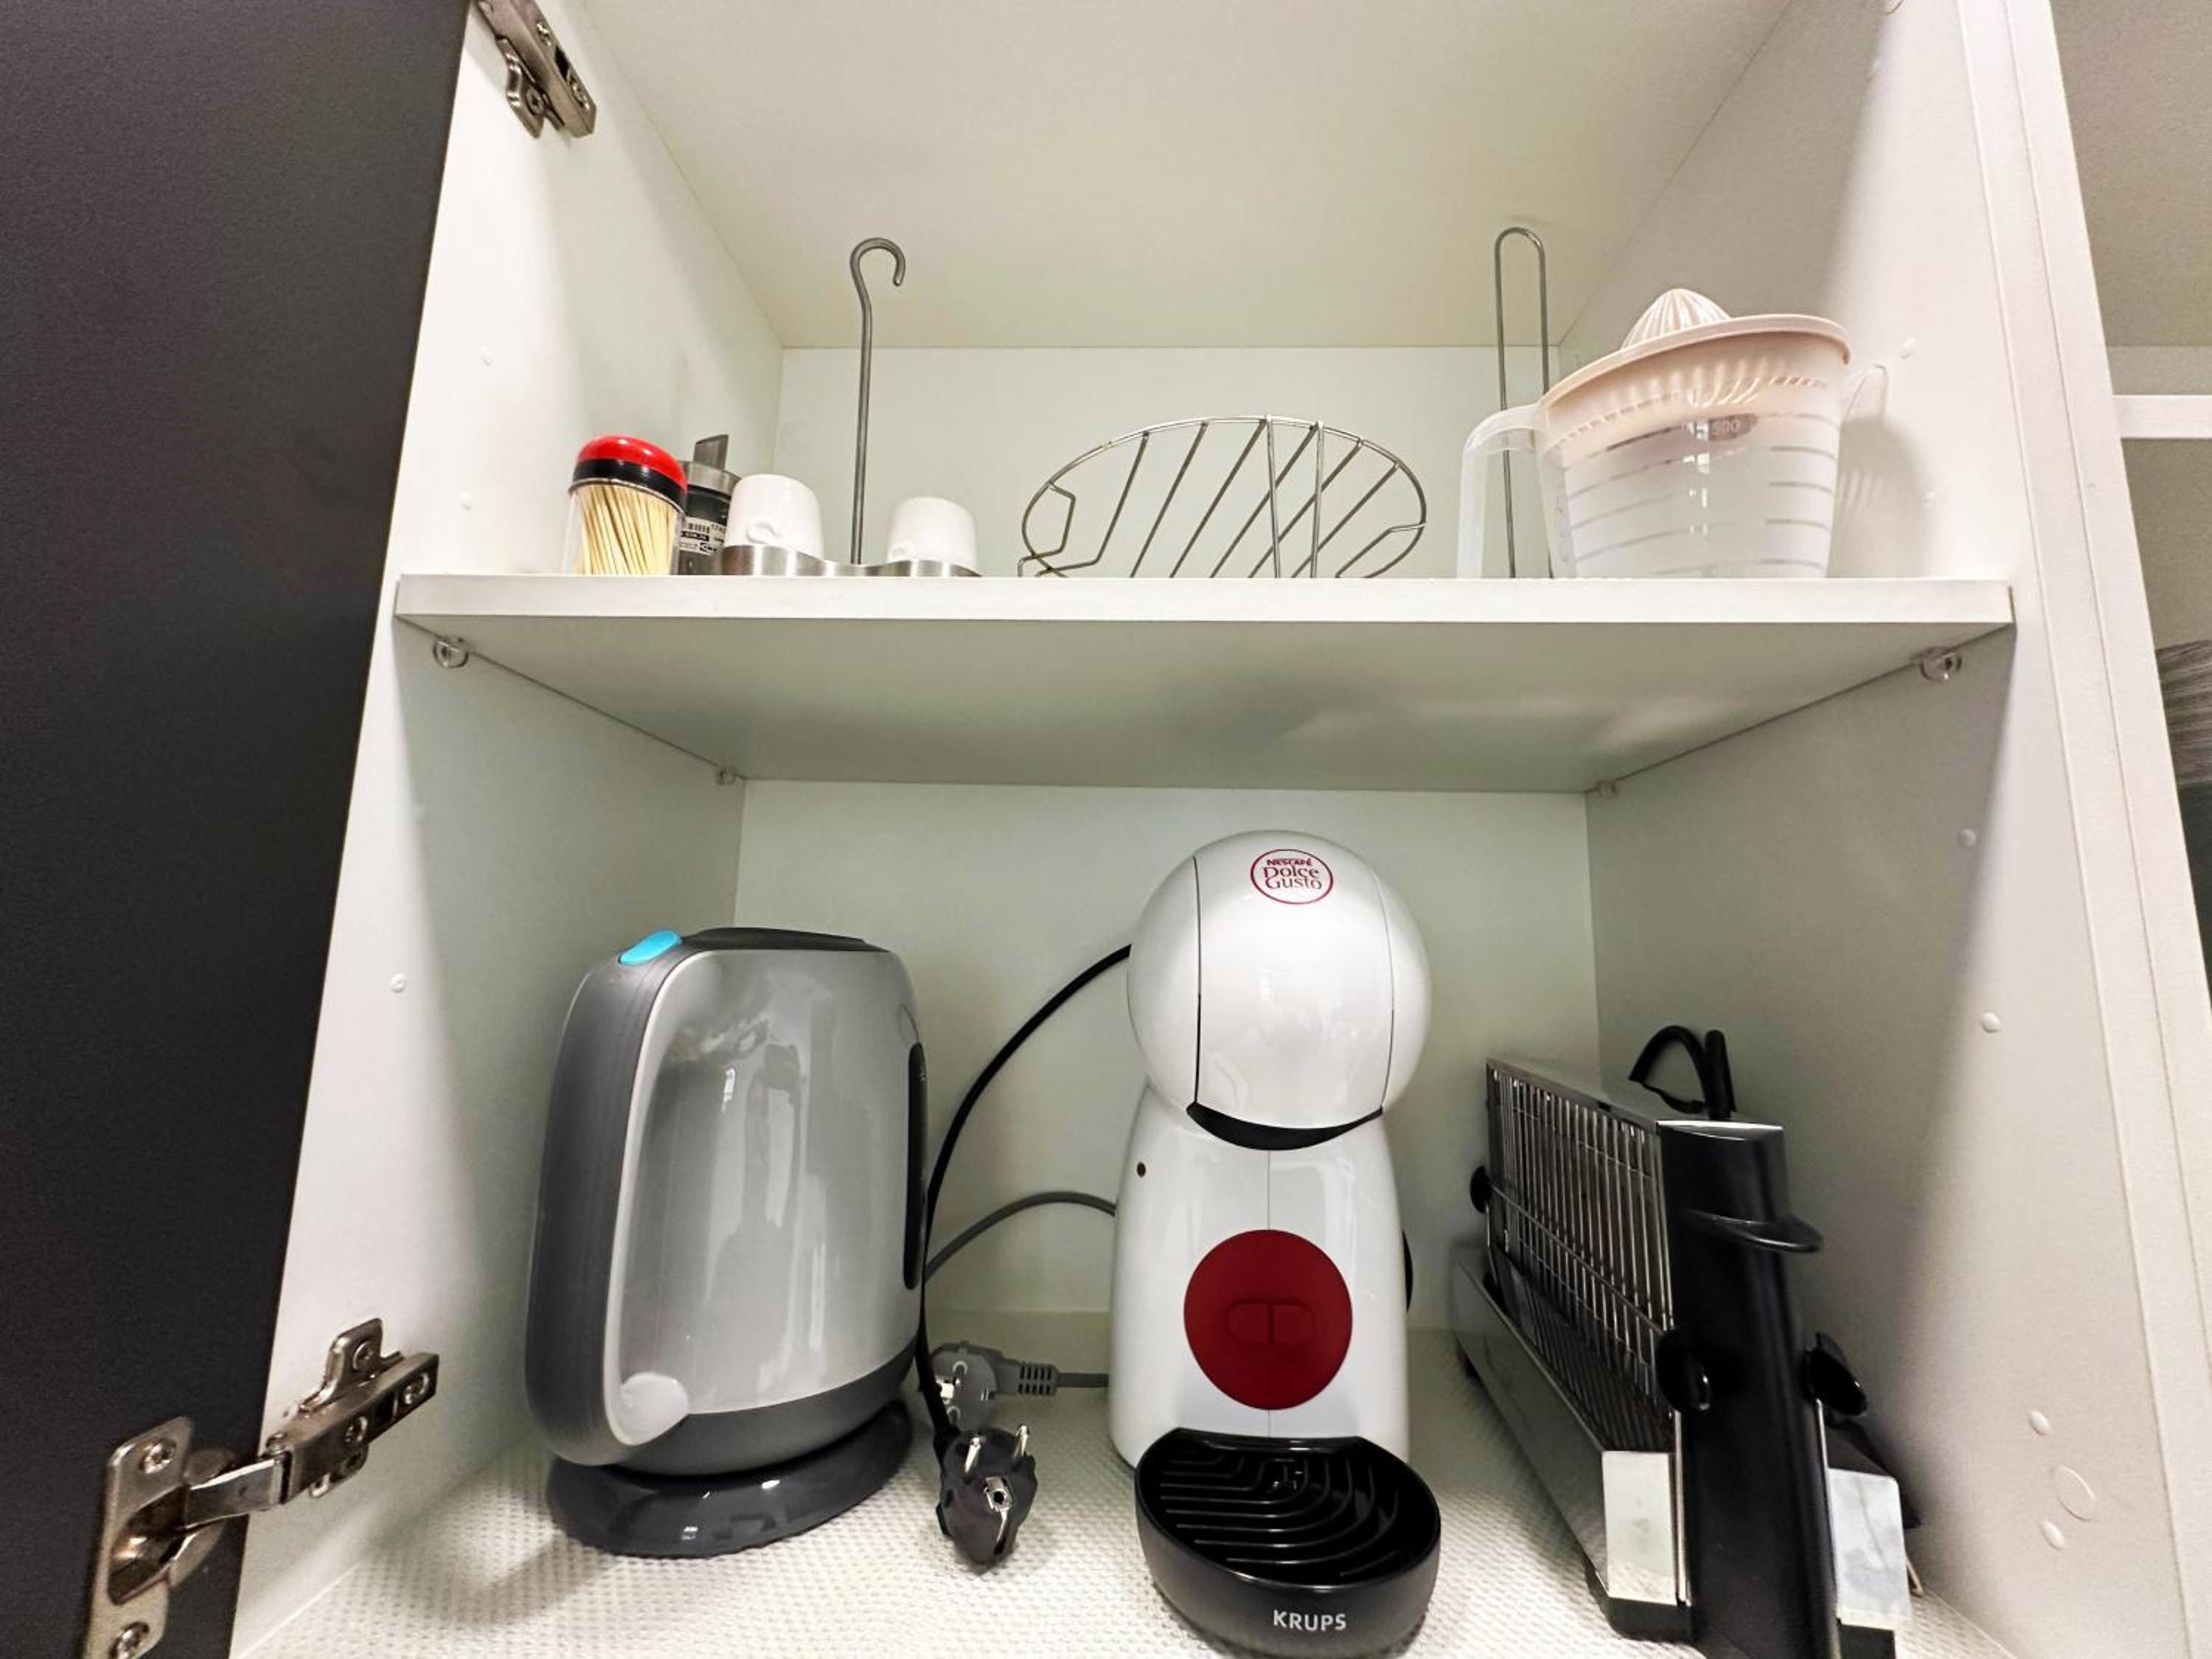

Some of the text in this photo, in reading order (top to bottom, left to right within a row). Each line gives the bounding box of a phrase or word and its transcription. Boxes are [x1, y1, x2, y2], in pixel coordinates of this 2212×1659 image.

[1263, 865, 1319, 878] Dolce
[1265, 876, 1323, 890] Gusto
[1273, 1609, 1347, 1632] KRUPS
